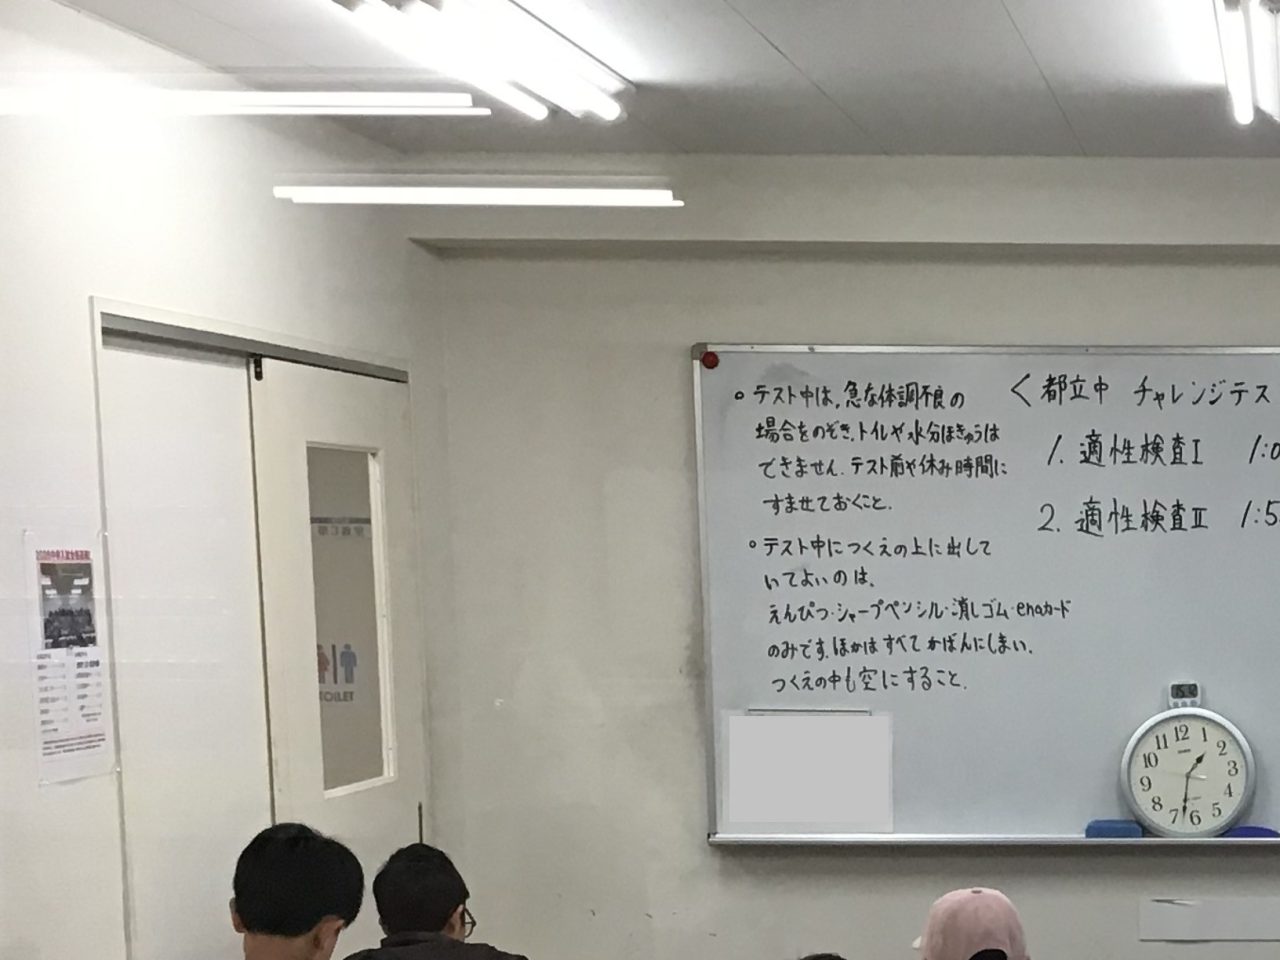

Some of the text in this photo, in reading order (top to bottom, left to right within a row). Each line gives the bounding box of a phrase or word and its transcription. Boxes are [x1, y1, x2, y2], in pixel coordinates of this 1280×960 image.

[763, 533, 993, 559] テスト中につくえの上に出して
[1174, 724, 1190, 742] 12
[1155, 733, 1169, 750] 11
[1217, 740, 1228, 756] 2
[1143, 752, 1159, 768] 10
[1227, 760, 1239, 776] 3
[1139, 776, 1152, 792] 9
[1223, 783, 1233, 798] 4
[1151, 796, 1163, 812] 8
[1211, 802, 1222, 818] 5
[1169, 808, 1179, 824] 7
[1189, 810, 1202, 826] 6
